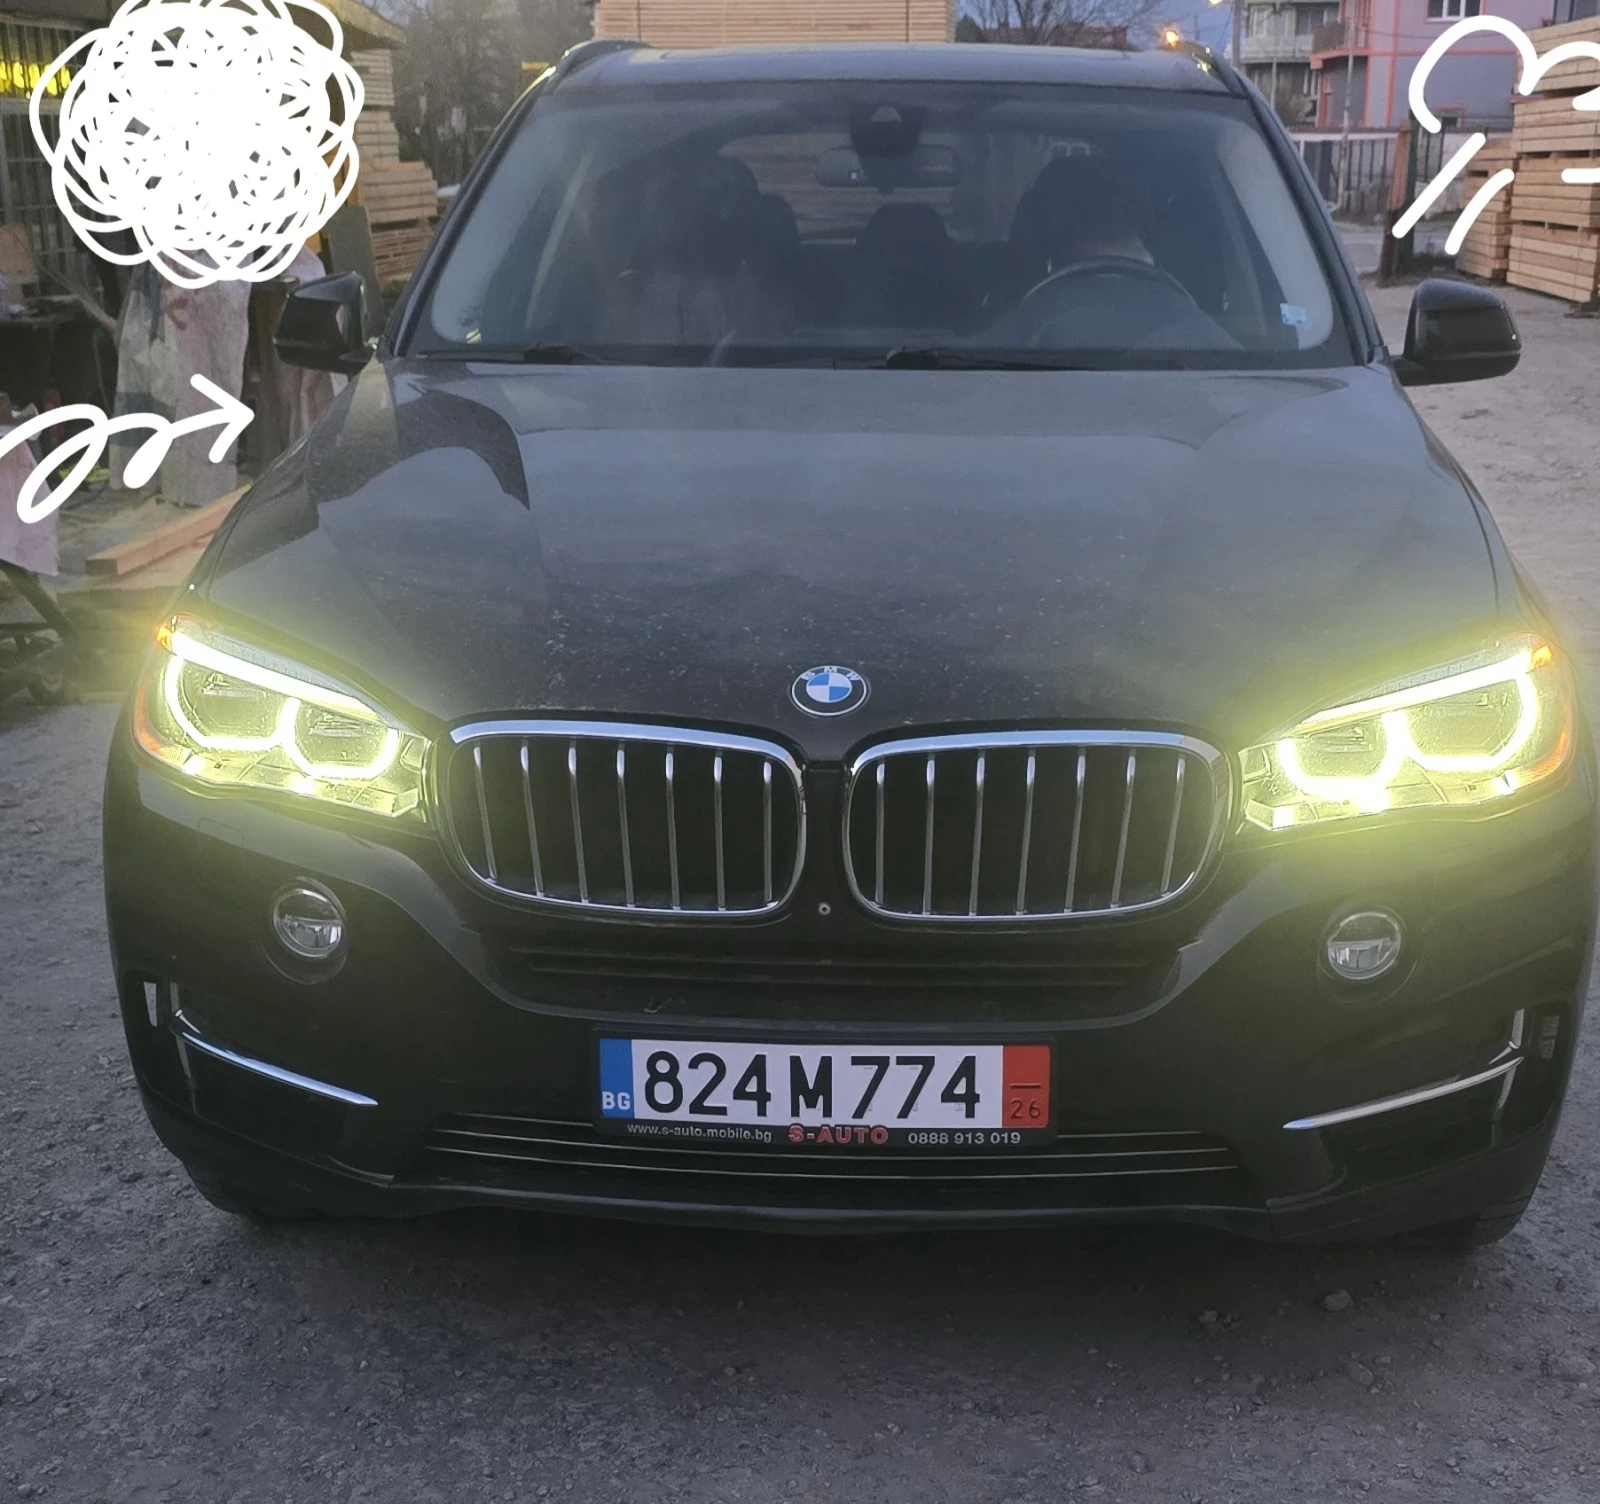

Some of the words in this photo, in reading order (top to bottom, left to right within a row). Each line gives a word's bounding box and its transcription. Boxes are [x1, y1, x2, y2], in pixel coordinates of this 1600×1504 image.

[644, 1050, 772, 1118] 824
[789, 1055, 833, 1118] M
[850, 1055, 981, 1119] 774
[601, 1091, 631, 1111] BG
[1010, 1099, 1042, 1119] 26
[626, 1123, 773, 1144] www.s-auto.mobile.bg
[787, 1124, 889, 1145] S-AUTO
[907, 1132, 949, 1145] 0888
[953, 1132, 985, 1145] 913
[990, 1131, 1021, 1145] 019
